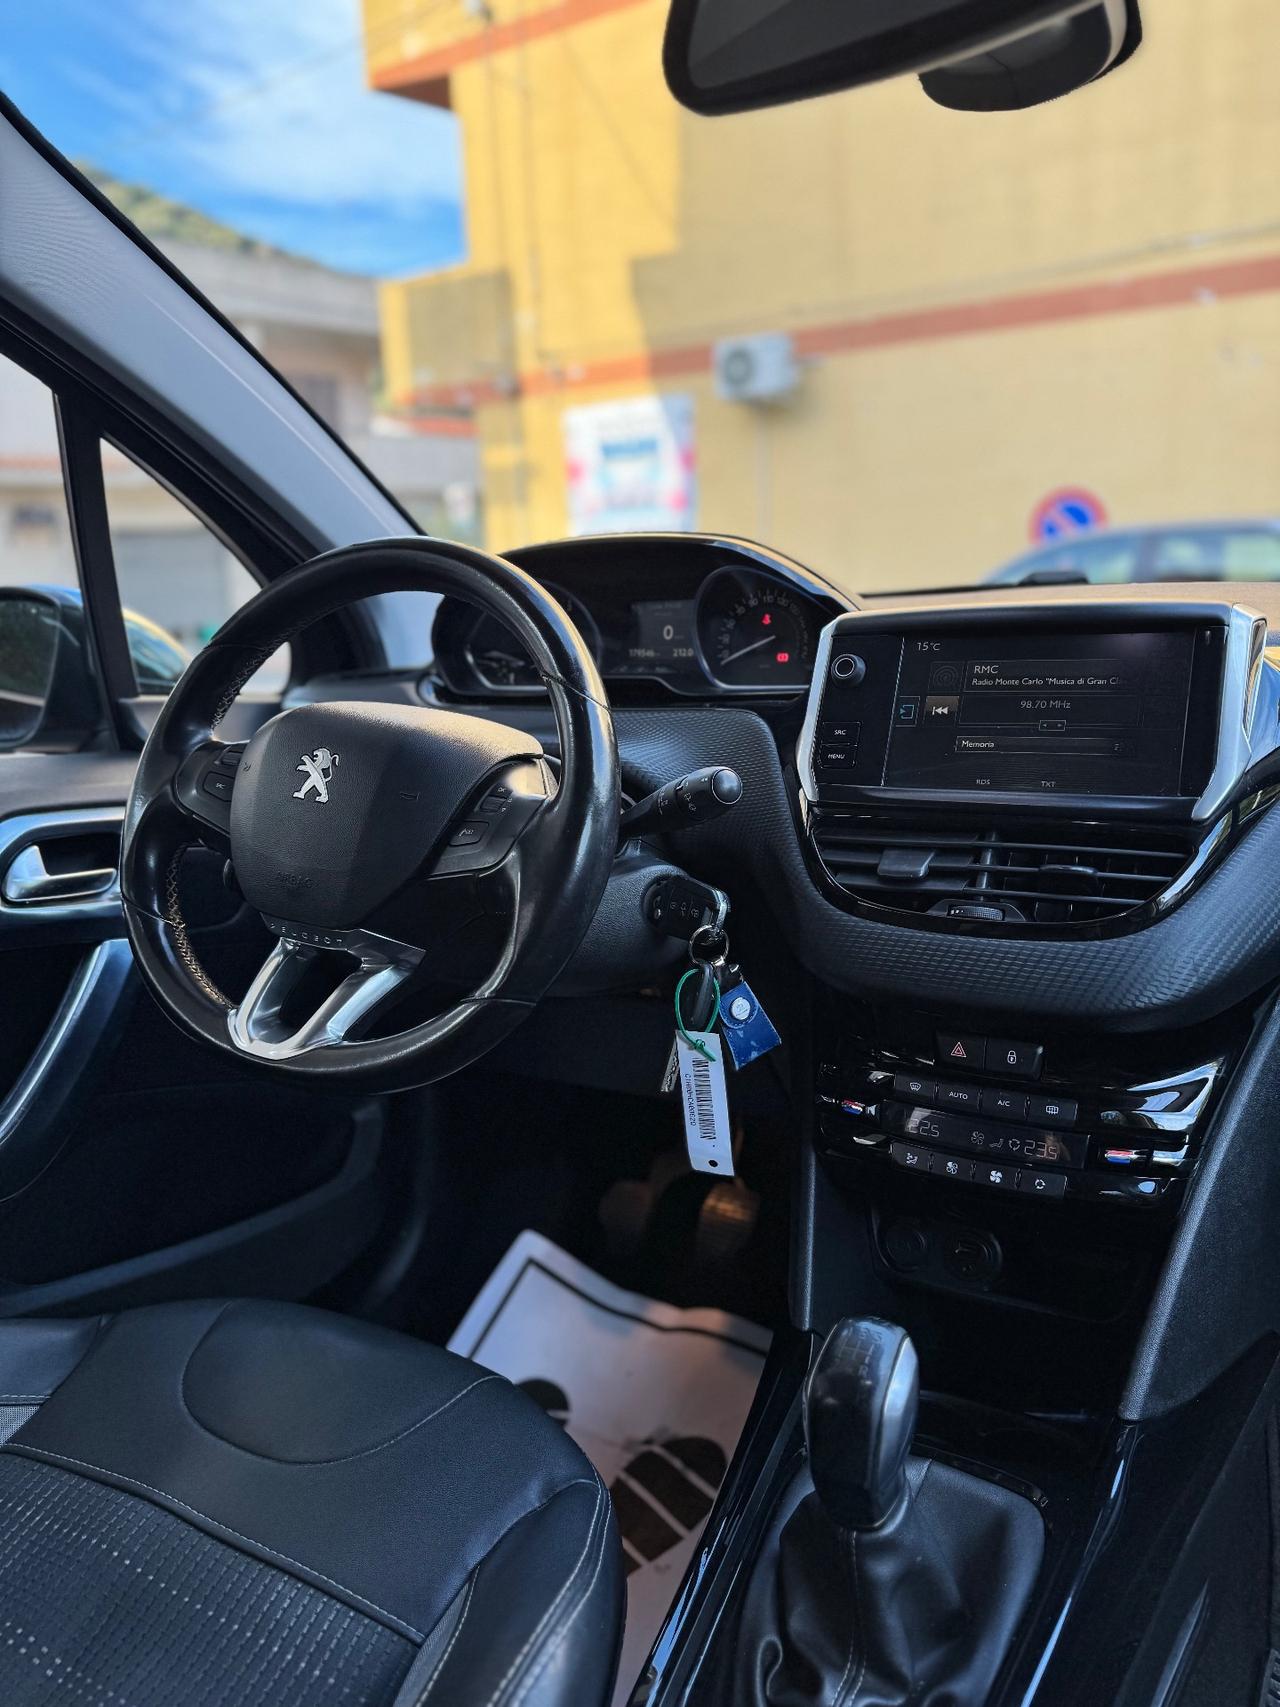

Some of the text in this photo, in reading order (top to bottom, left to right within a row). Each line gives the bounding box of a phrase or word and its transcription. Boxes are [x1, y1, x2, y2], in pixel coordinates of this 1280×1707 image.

[663, 624, 674, 641] 0
[973, 664, 1000, 675] RMC
[971, 678, 994, 687] Radio
[995, 677, 1020, 686] Monte
[1021, 677, 1044, 686] Carlo
[1045, 677, 1075, 686] "Musica
[1076, 677, 1086, 686] di
[1087, 677, 1108, 686] Gran
[1019, 700, 1072, 710] 98.70 MHz
[961, 740, 995, 748] Memoria
[948, 1090, 969, 1101] AUTO
[997, 1099, 1011, 1107] A/C
